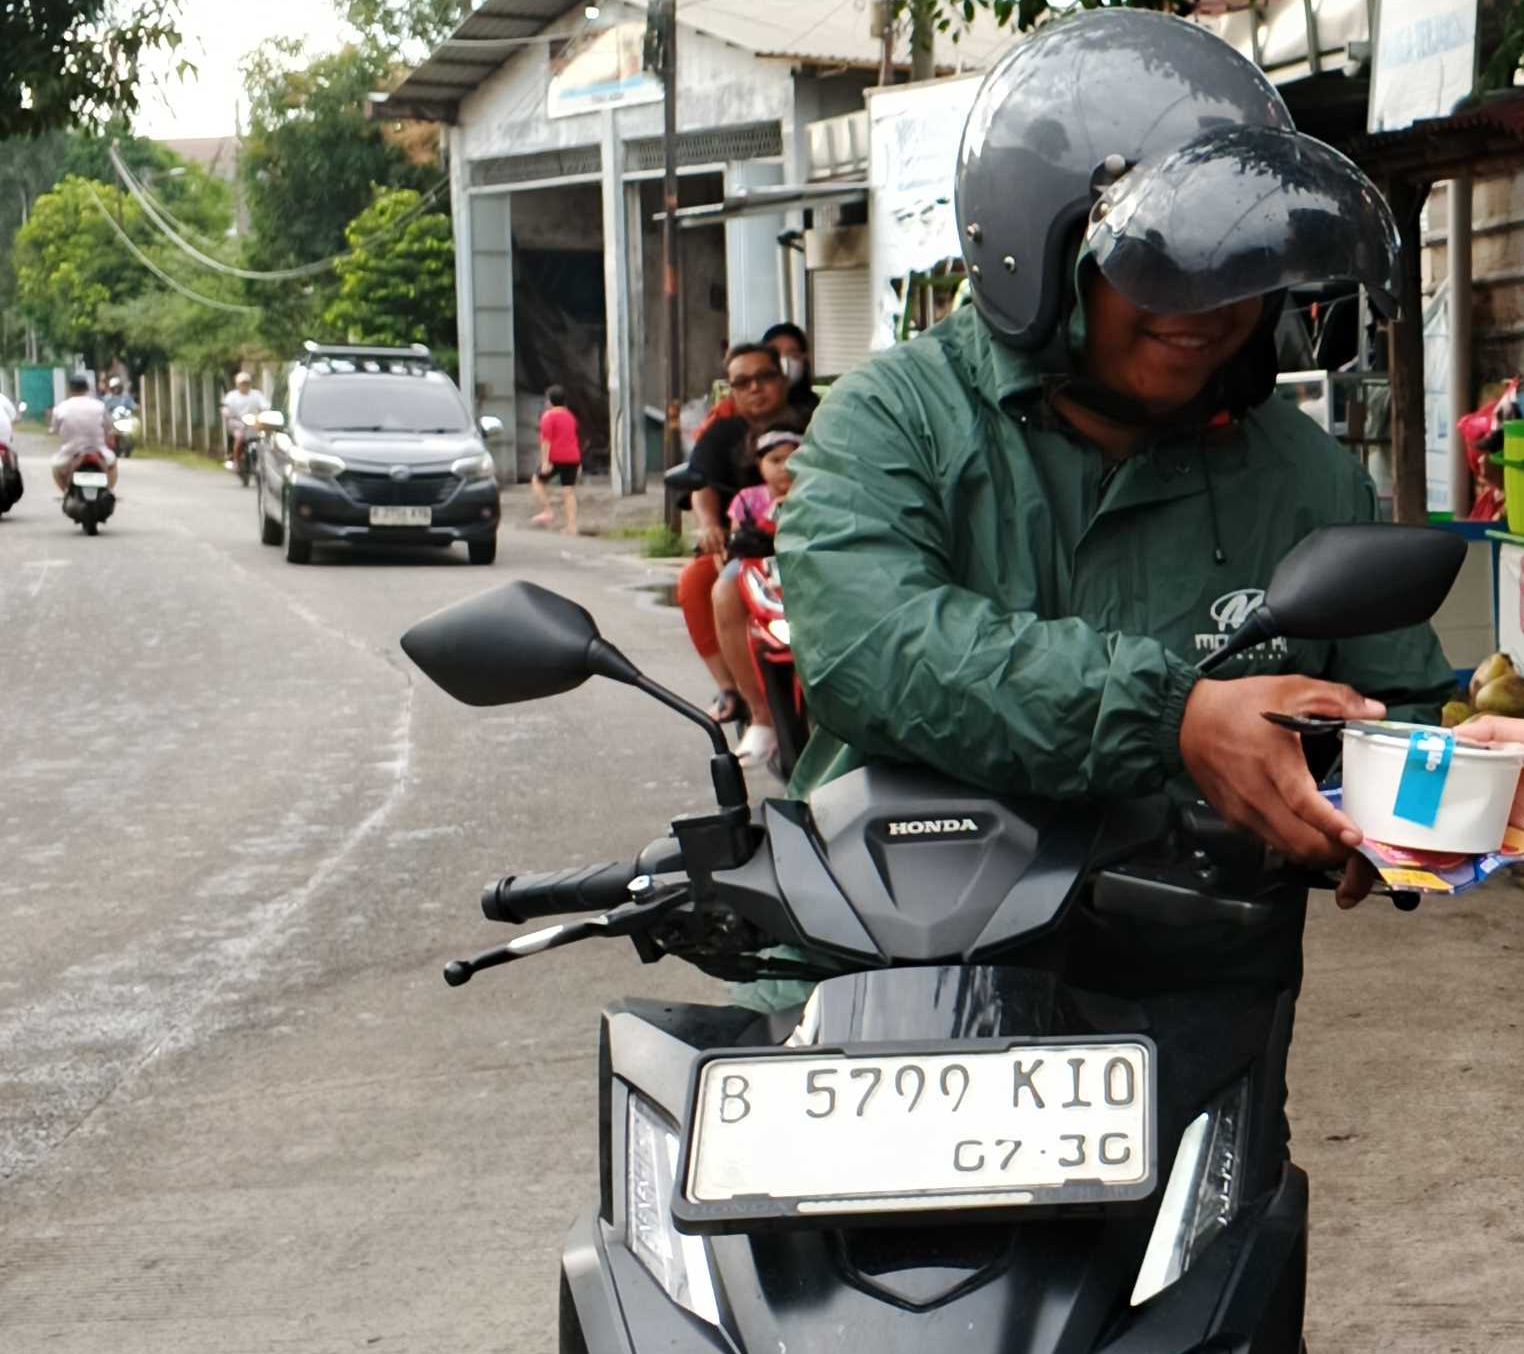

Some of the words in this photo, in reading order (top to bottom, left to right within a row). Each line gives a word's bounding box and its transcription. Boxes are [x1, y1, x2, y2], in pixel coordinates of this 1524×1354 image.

[888, 818, 979, 836] HONDA
[719, 1074, 752, 1124] B
[805, 1063, 970, 1119] 5799
